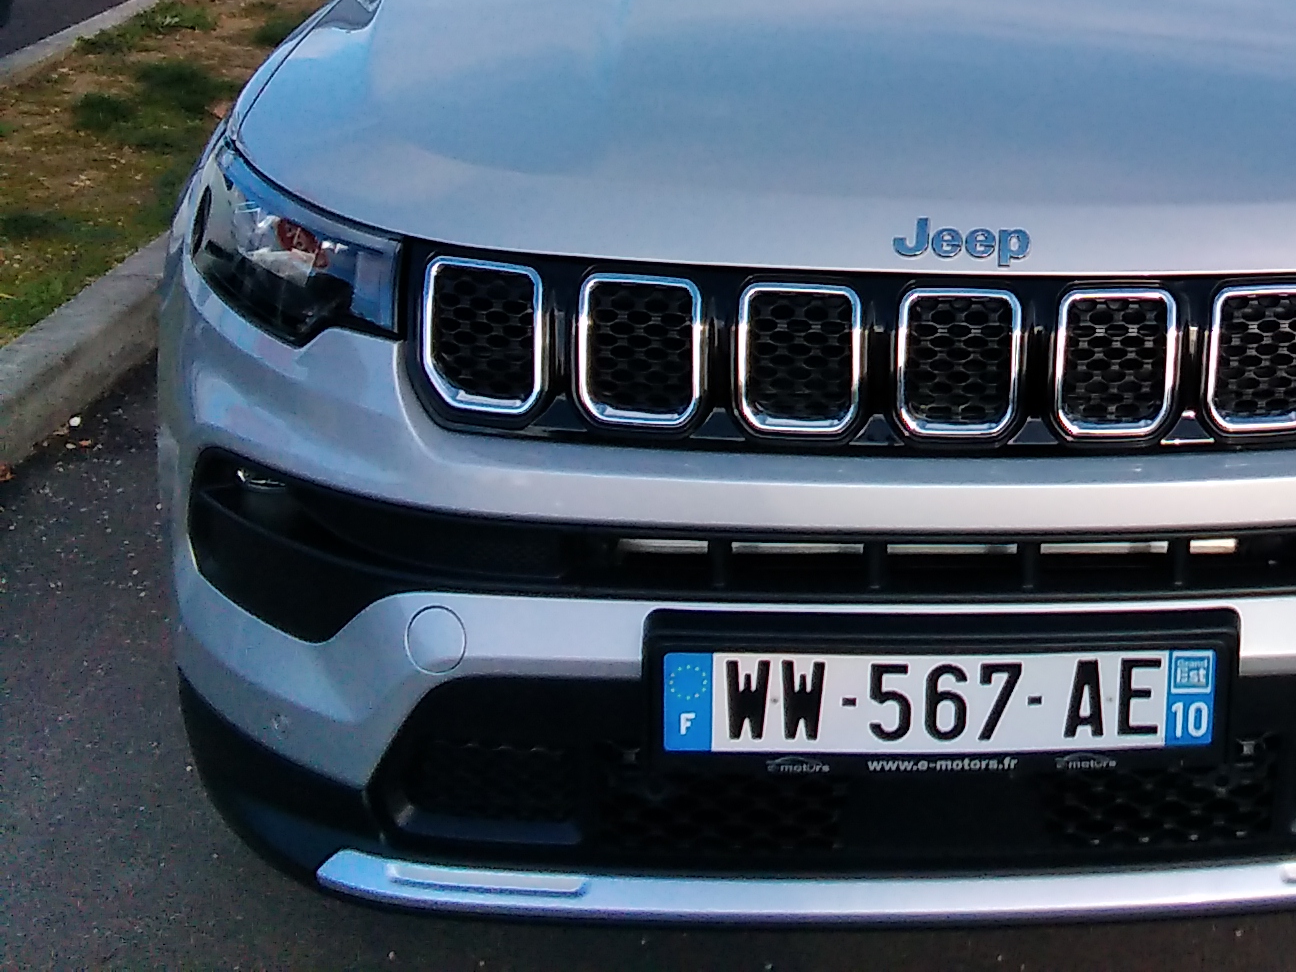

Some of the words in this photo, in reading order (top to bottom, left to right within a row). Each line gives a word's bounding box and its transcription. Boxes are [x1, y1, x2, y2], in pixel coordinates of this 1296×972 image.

[893, 216, 1031, 267] Jeep
[679, 712, 696, 736] F
[1171, 701, 1209, 739] 10
[867, 756, 1019, 771] www.e-motors.fr
